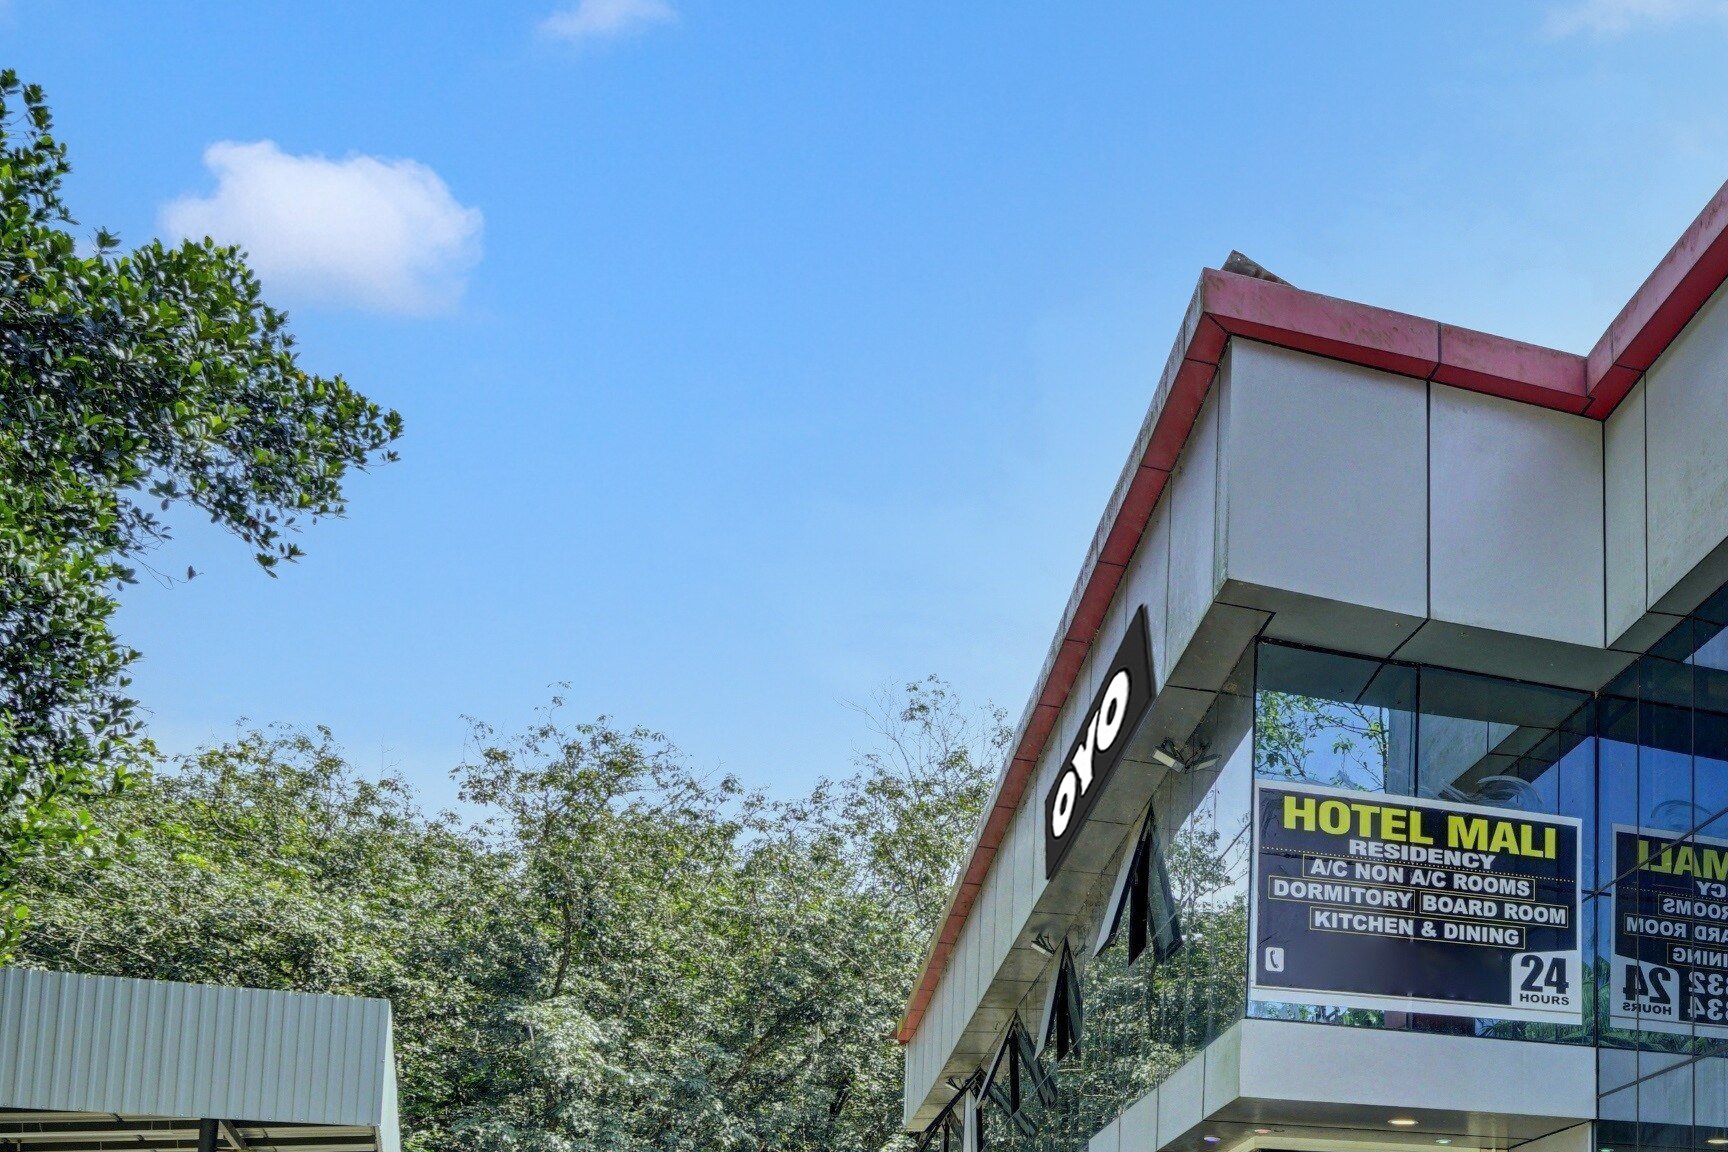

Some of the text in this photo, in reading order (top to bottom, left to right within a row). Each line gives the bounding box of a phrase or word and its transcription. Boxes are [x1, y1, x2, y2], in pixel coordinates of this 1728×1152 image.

[1052, 670, 1130, 838] OYO
[1283, 795, 1557, 860] HOTEL MALI
[1349, 838, 1496, 871] RESIDENCY
[1310, 858, 1531, 897] A/C NON A/C ROOMS
[1273, 879, 1567, 925] DORMITORY BOARD ROOM
[1314, 910, 1520, 945] KITCHEN & DINING
[1520, 954, 1569, 995] 24
[1519, 993, 1570, 1006] HOURS
